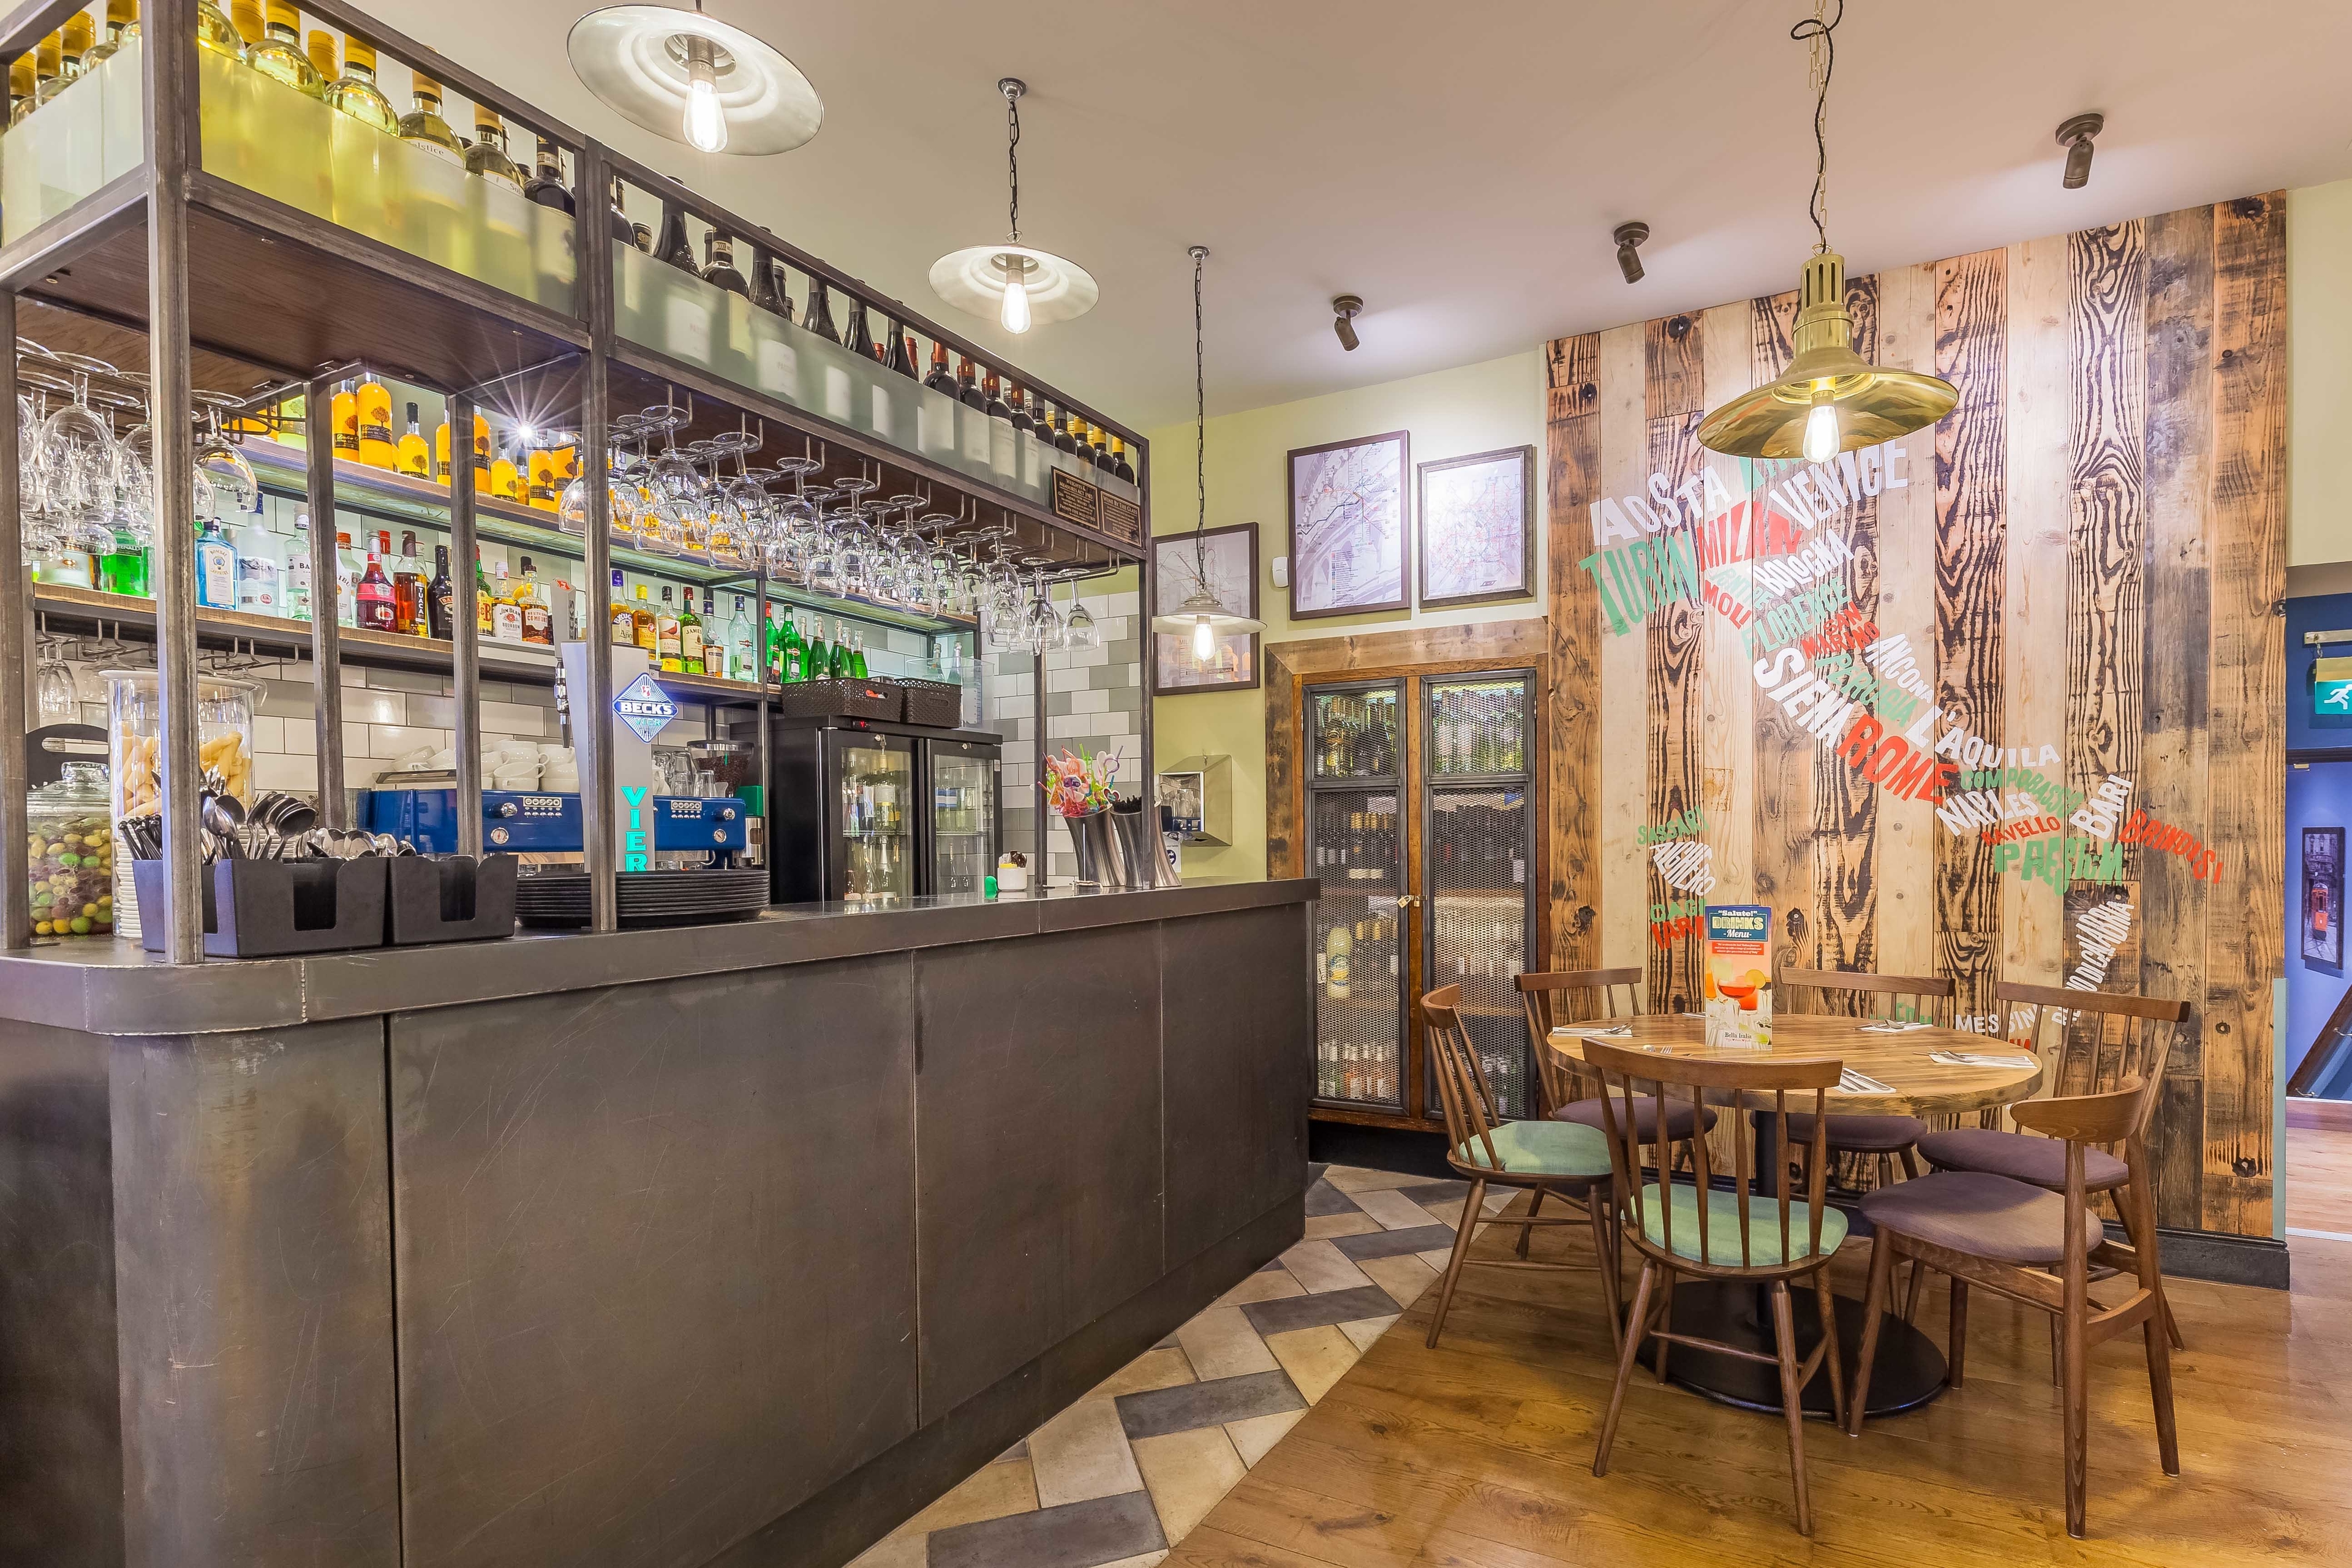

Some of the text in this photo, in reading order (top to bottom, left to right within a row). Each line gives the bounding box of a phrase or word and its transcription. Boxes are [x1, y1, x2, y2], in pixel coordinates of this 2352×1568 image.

[1589, 465, 1732, 546] AOSTA
[1769, 439, 1908, 530] VENICE
[1697, 500, 1803, 572] MILAN
[1747, 529, 1855, 597] BOLOGNA
[338, 575, 350, 587] IBU
[1578, 531, 1698, 638] TURIN
[613, 612, 633, 624] BRUG
[1741, 576, 1850, 660] FLORENCE
[1801, 621, 1880, 659] MARINO
[1823, 601, 1863, 635] SAN
[1754, 647, 1855, 748] SIENA
[1815, 653, 1919, 728] PERUGIA
[1865, 633, 1934, 703] ANCONA
[1836, 714, 1959, 804] ROME
[1904, 704, 2060, 771] L'AQUILA
[621, 786, 647, 872] VIER
[1637, 805, 1709, 845] SASSARI
[1936, 789, 2038, 837] NAPLES
[1981, 816, 2060, 846] RAVELLO
[2069, 774, 2133, 840] BARI
[1649, 841, 1716, 896] ALGHERO
[2118, 808, 2223, 884] BRINDISI
[1712, 916, 1764, 930] DRINKS
[2075, 900, 2135, 968] CALABRIA
[2075, 962, 2105, 984] DI
